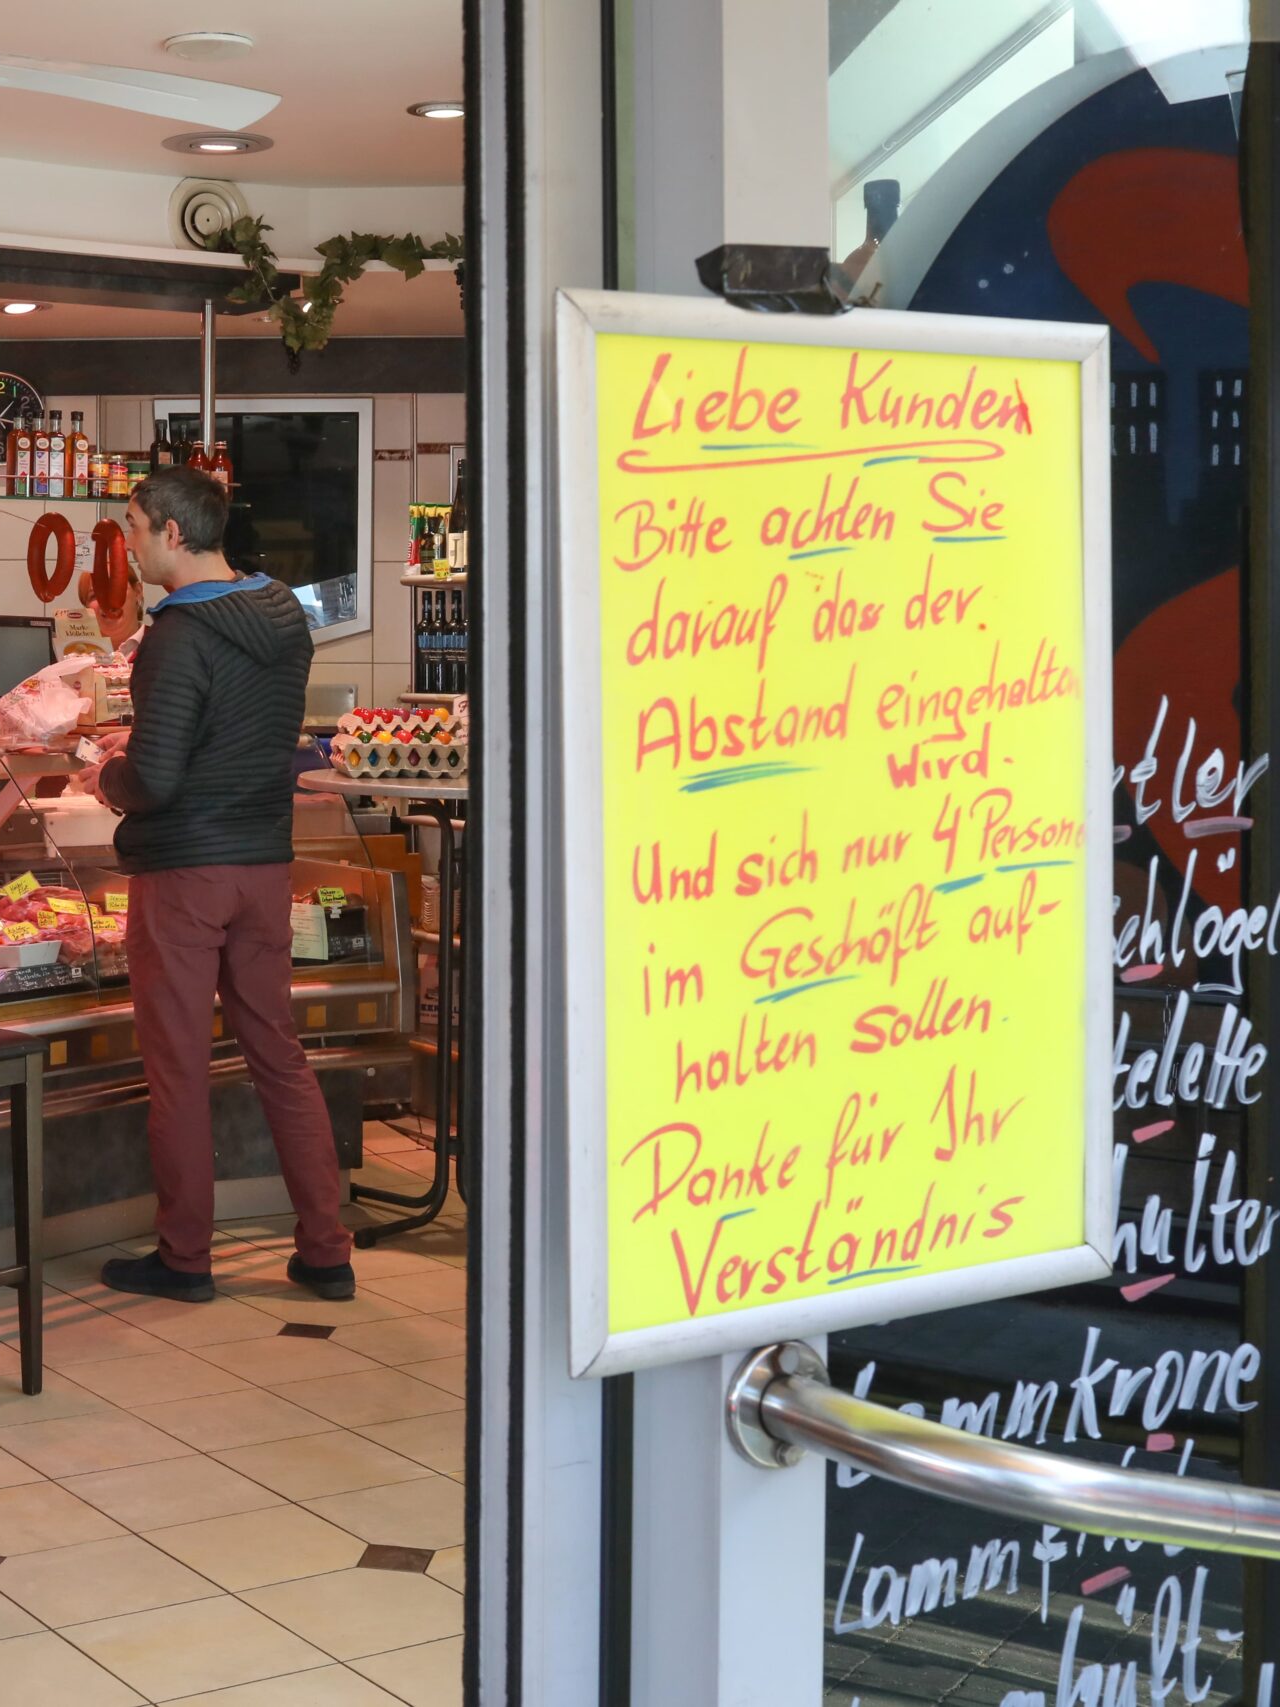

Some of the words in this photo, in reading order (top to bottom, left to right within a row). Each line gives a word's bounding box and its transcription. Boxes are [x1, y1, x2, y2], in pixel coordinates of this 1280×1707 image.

[631, 346, 803, 440] Liebe
[613, 496, 733, 573] Bitte
[760, 472, 896, 551] achten
[920, 471, 1007, 534] Sie
[626, 573, 789, 673] darauf
[635, 663, 858, 774] Abstand
[631, 829, 719, 906] Und
[734, 809, 819, 898] sich
[842, 829, 913, 873] nur
[931, 792, 962, 875] 4
[643, 942, 706, 1017] im
[968, 868, 1063, 956] auf-
[675, 1013, 817, 1104] halten
[621, 1121, 802, 1224] Danke
[825, 1091, 905, 1210] für
[930, 1062, 1027, 1163] Ihr
[669, 1180, 1027, 1318] Verständnis
